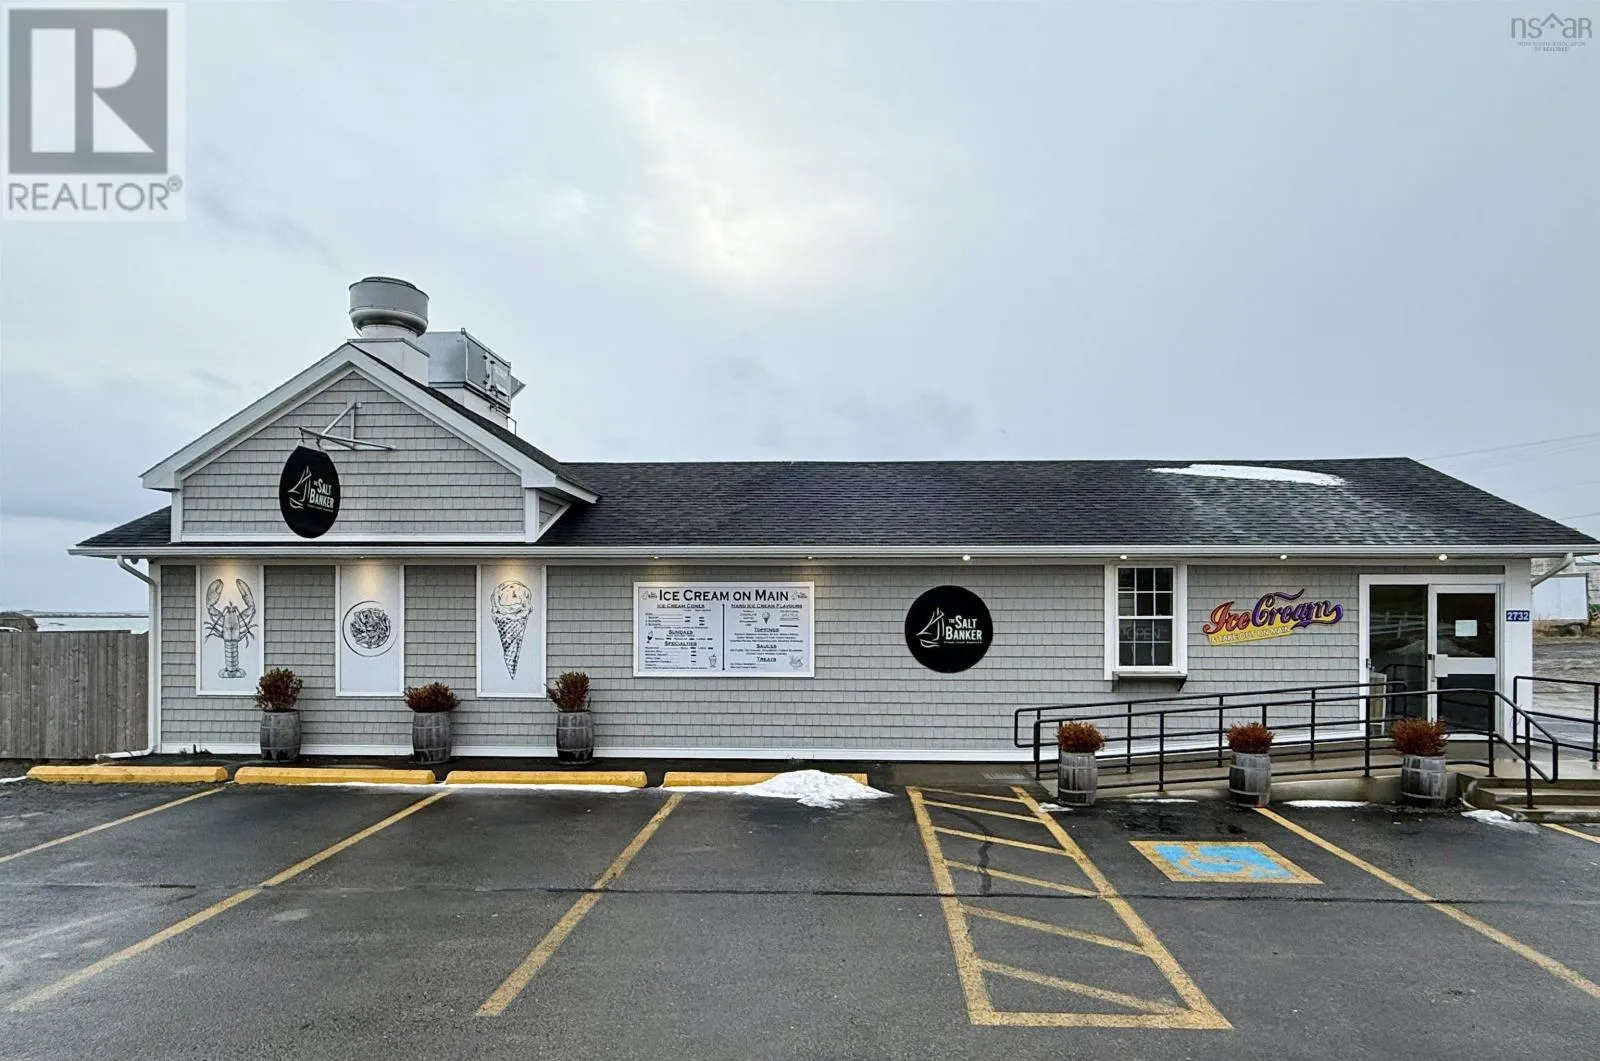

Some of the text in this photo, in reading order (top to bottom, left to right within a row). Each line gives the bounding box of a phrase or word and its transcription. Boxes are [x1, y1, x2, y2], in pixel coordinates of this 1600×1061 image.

[317, 478, 332, 496] SALT
[309, 488, 334, 509] BANKER
[659, 589, 680, 601] ICE
[683, 589, 730, 601] CREAM
[733, 591, 751, 601] ON
[755, 589, 789, 601] MAIN
[1202, 588, 1344, 635] Ice Cream
[1507, 612, 1529, 621] 2732
[955, 614, 978, 629] SALT
[945, 626, 983, 641] BANKER
[1270, 626, 1291, 635] MAIN
